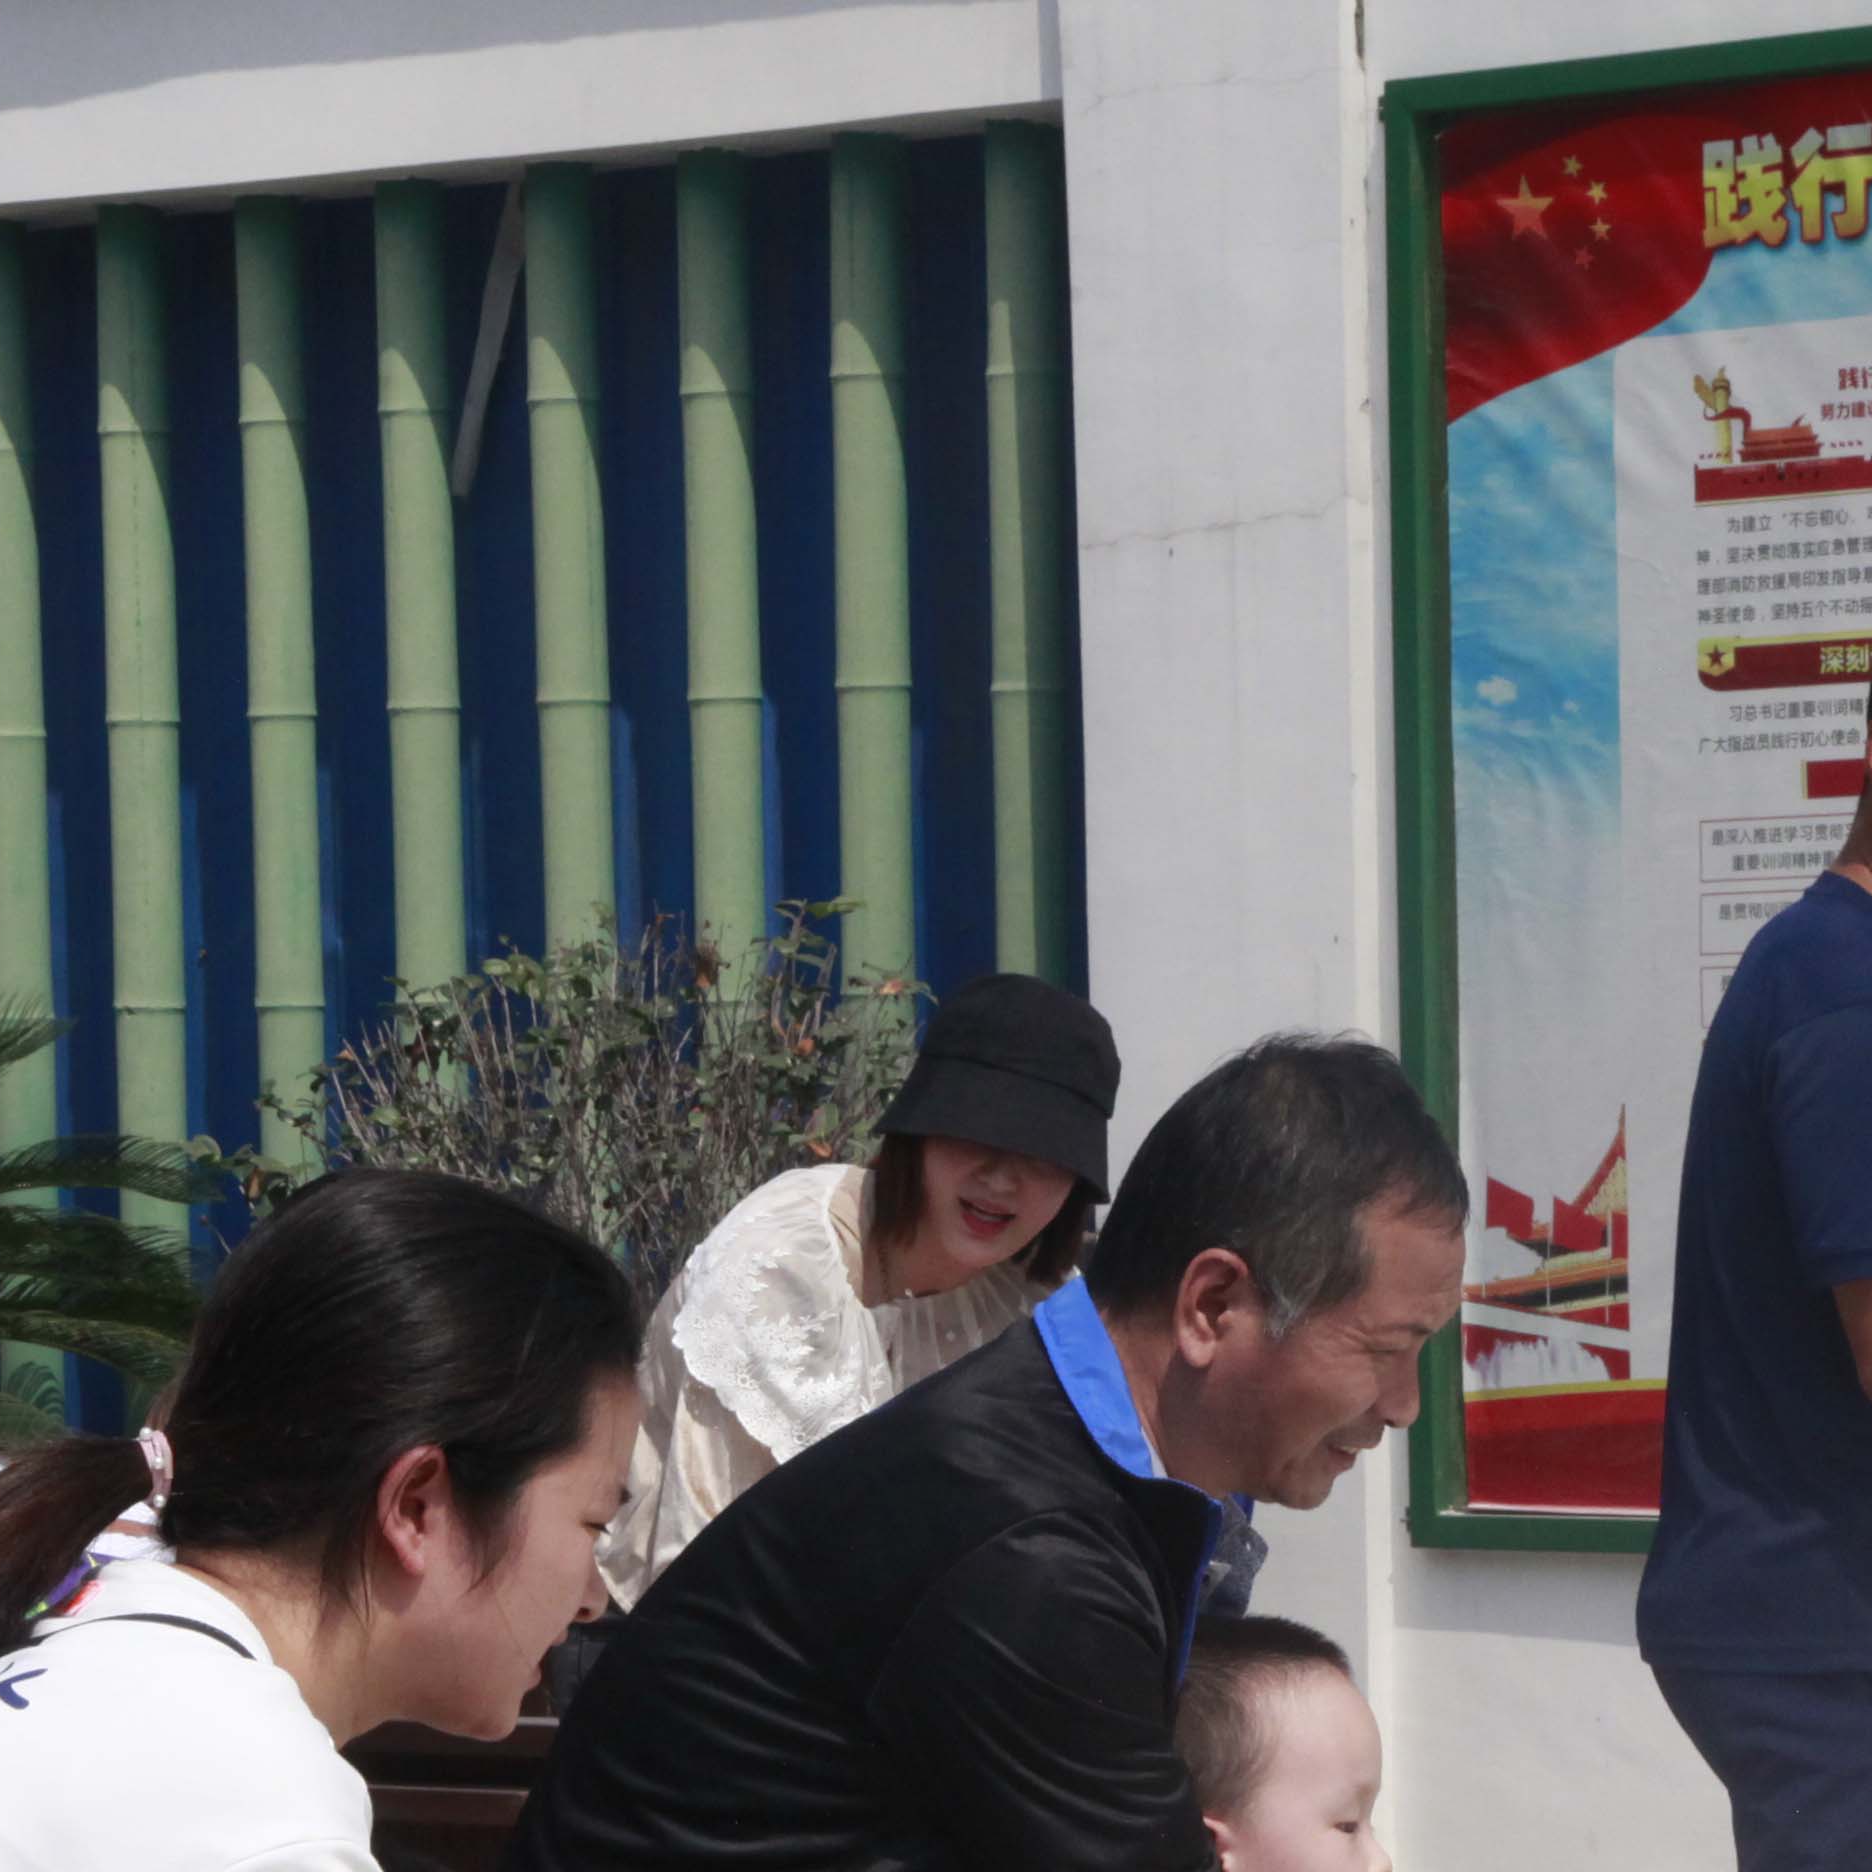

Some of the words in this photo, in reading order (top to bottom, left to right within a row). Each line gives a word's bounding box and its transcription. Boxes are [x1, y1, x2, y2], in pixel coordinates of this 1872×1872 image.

[1729, 697, 1868, 723] 习总书记重要训词精
